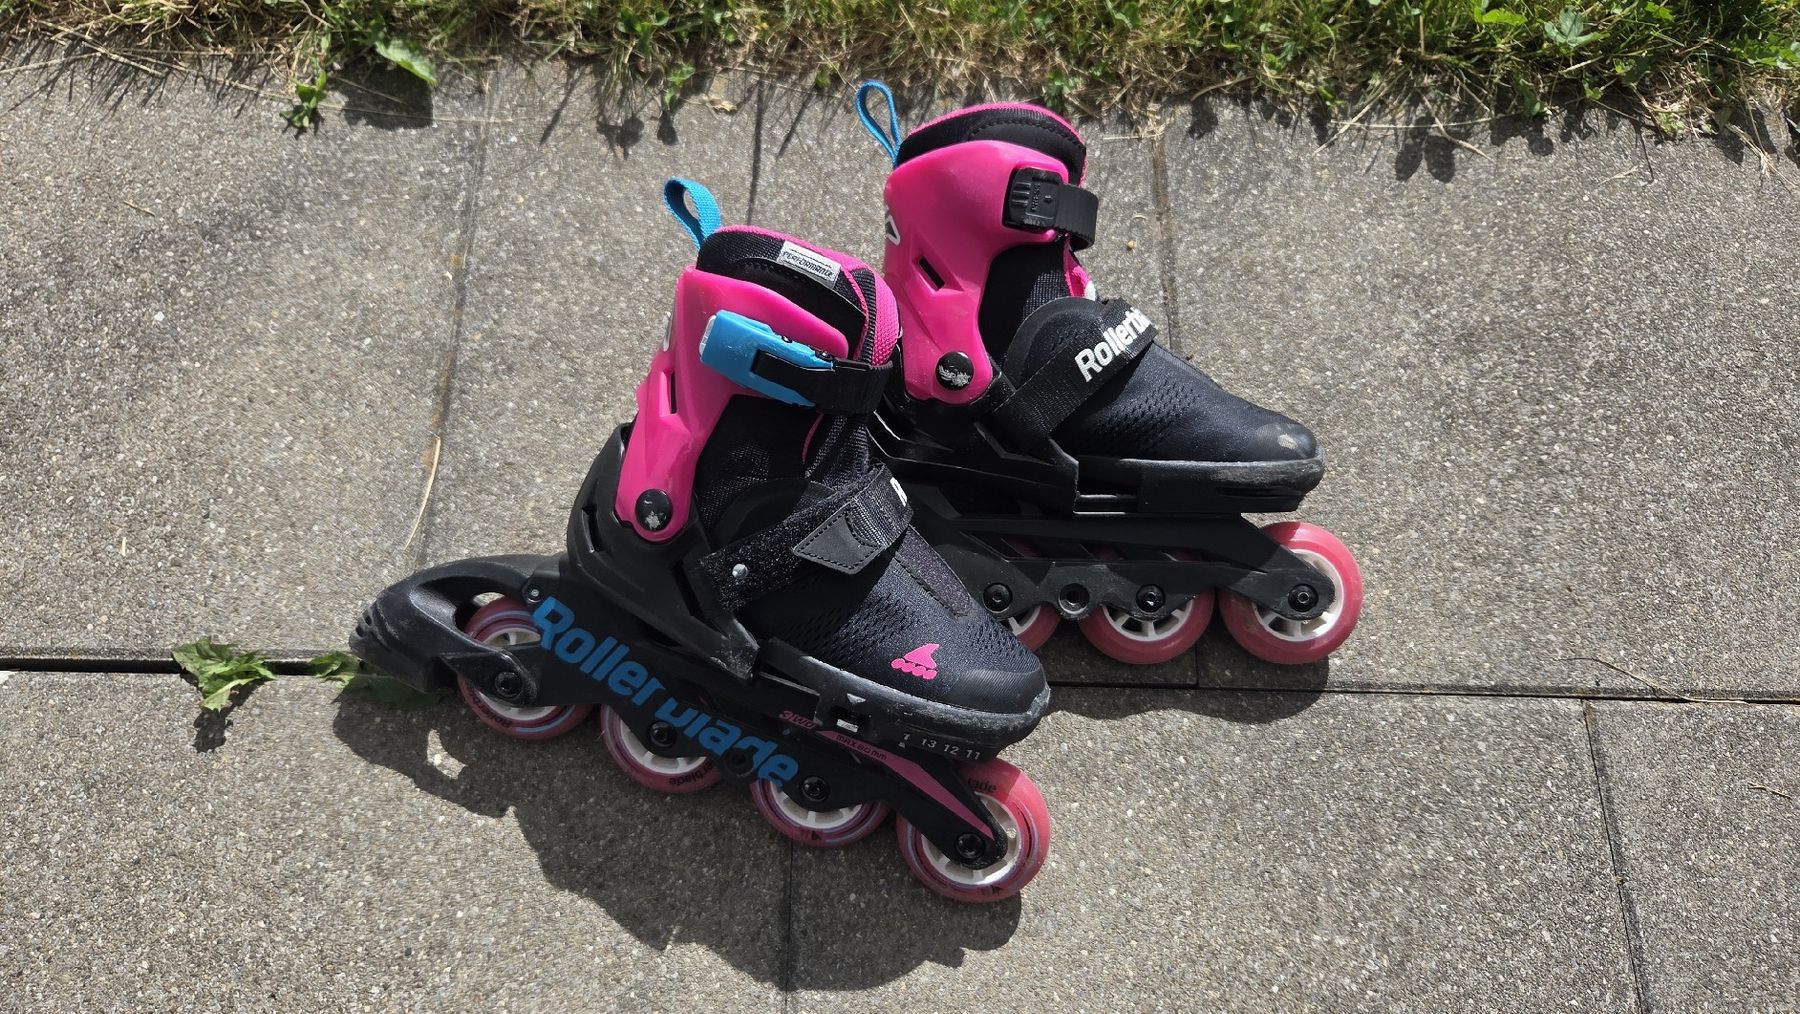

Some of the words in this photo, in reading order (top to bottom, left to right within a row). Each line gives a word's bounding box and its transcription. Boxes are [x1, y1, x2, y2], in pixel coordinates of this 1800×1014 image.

[781, 251, 836, 278] PERFORMANCE
[920, 737, 937, 749] 13
[943, 743, 960, 756] 12
[965, 749, 981, 761] 11
